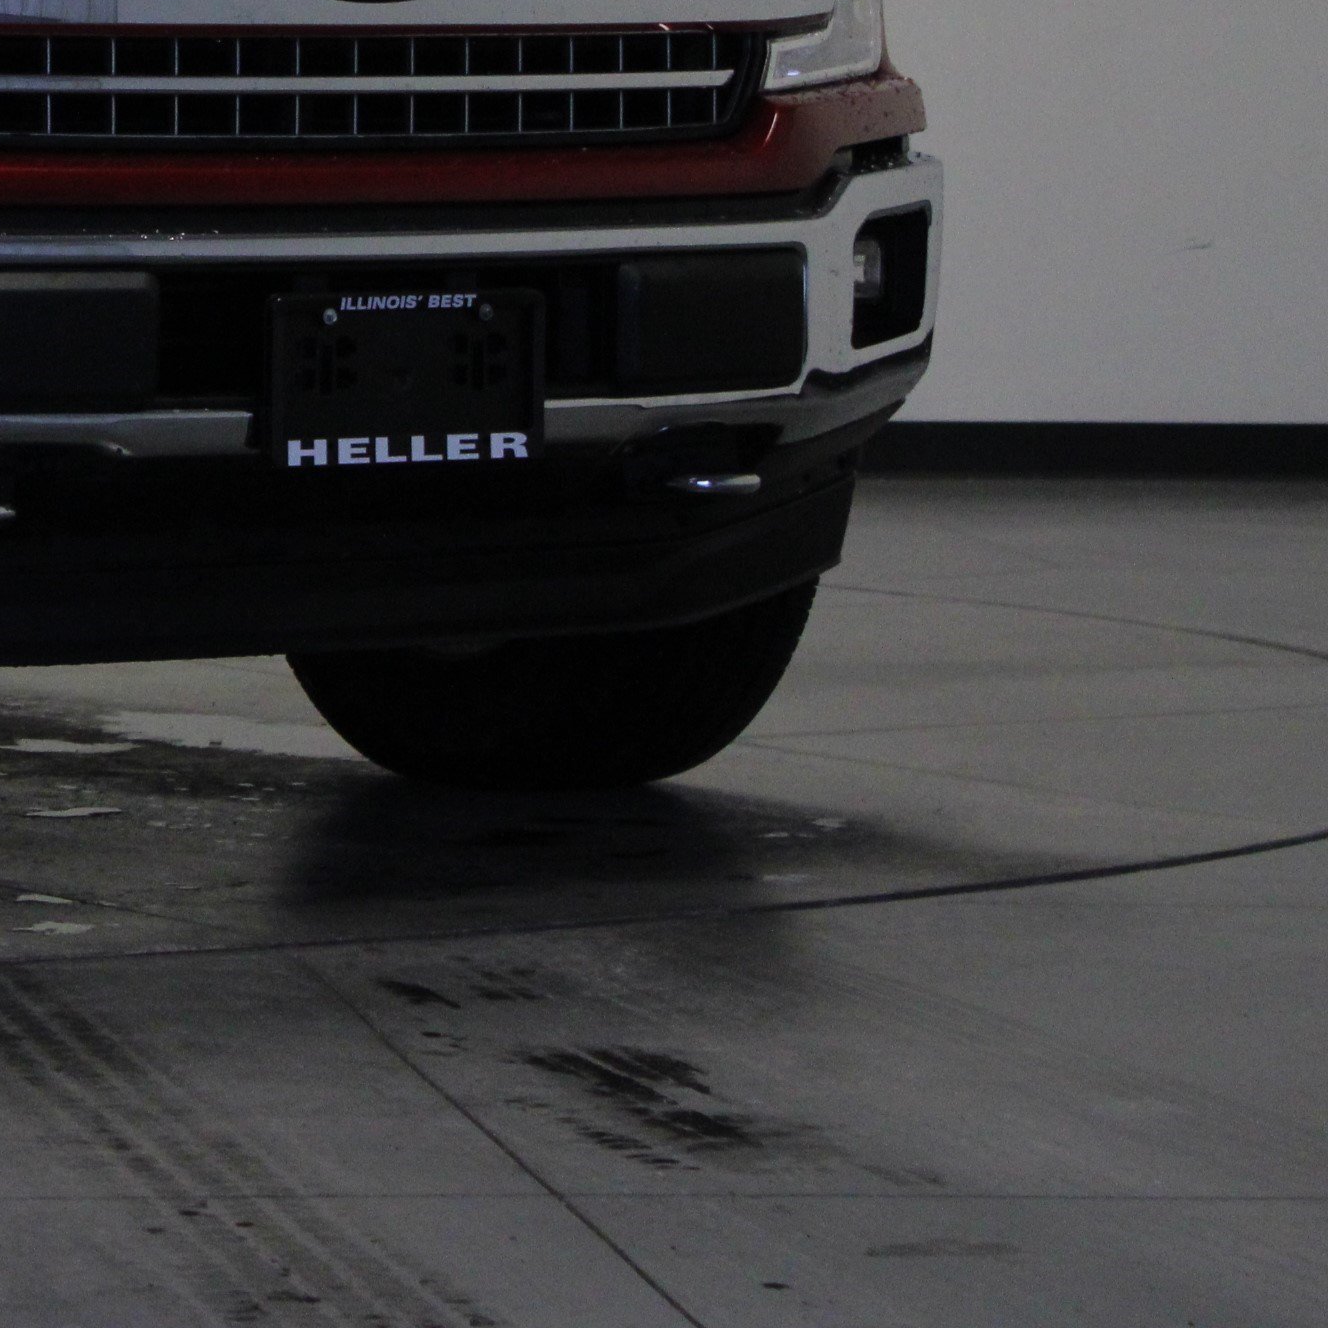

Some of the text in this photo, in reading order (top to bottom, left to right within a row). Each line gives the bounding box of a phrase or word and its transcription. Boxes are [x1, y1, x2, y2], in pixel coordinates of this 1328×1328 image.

[340, 293, 477, 312] ILLINOIS' BEST
[287, 431, 529, 467] HELLER
